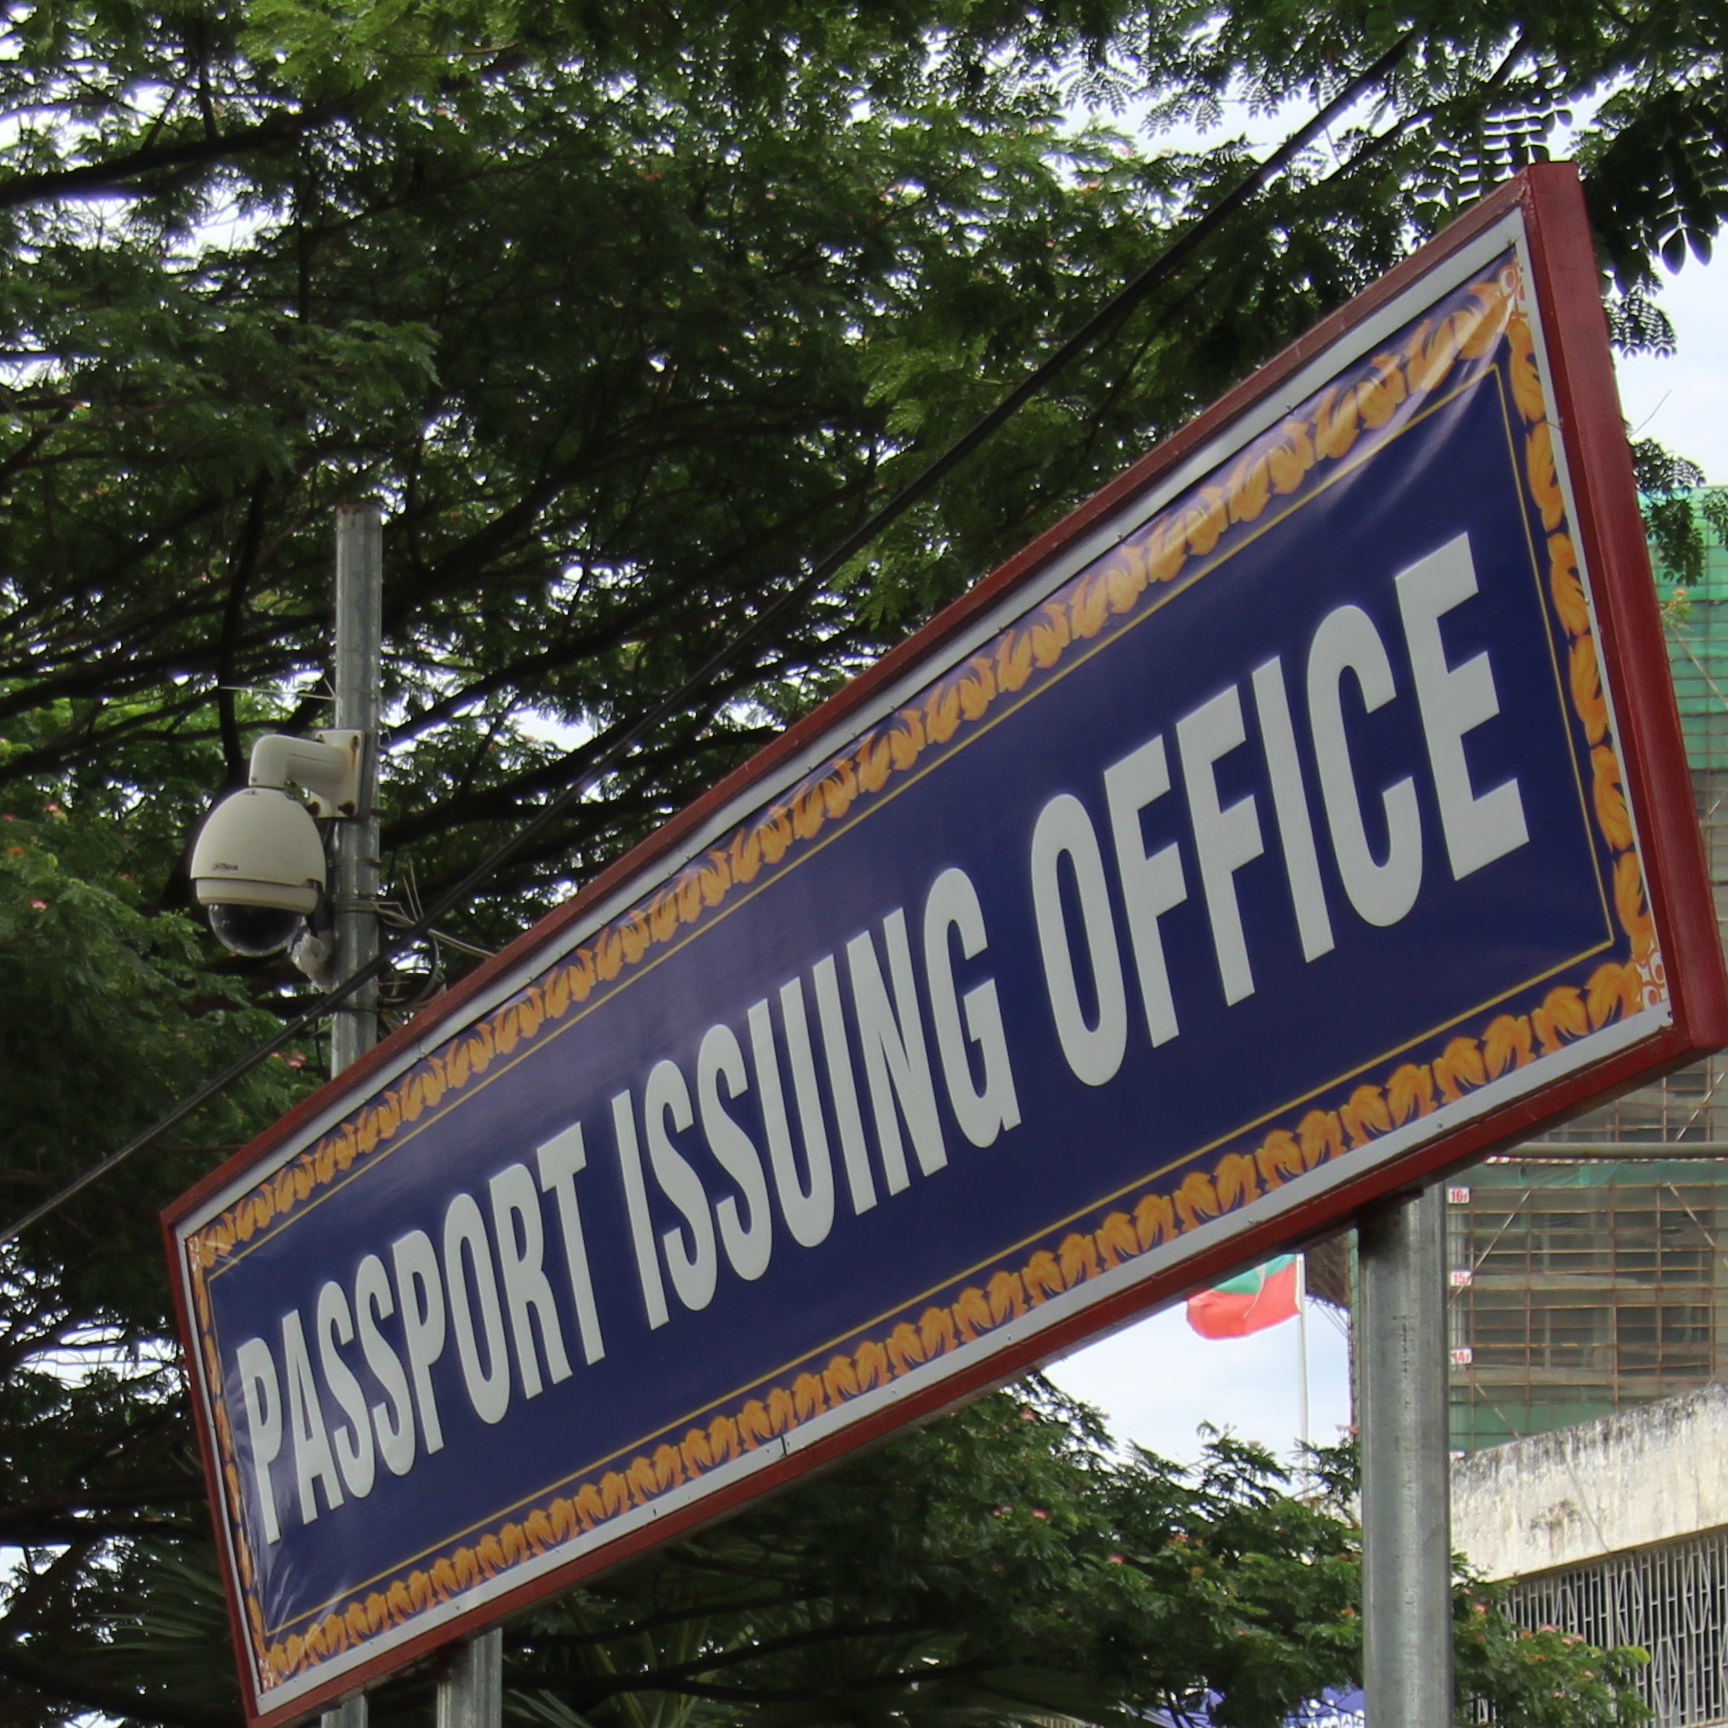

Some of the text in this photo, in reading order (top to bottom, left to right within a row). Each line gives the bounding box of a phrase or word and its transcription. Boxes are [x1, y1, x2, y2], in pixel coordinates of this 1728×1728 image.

[236, 531, 1529, 1544] PASSPORT ISSUING OFFICE
